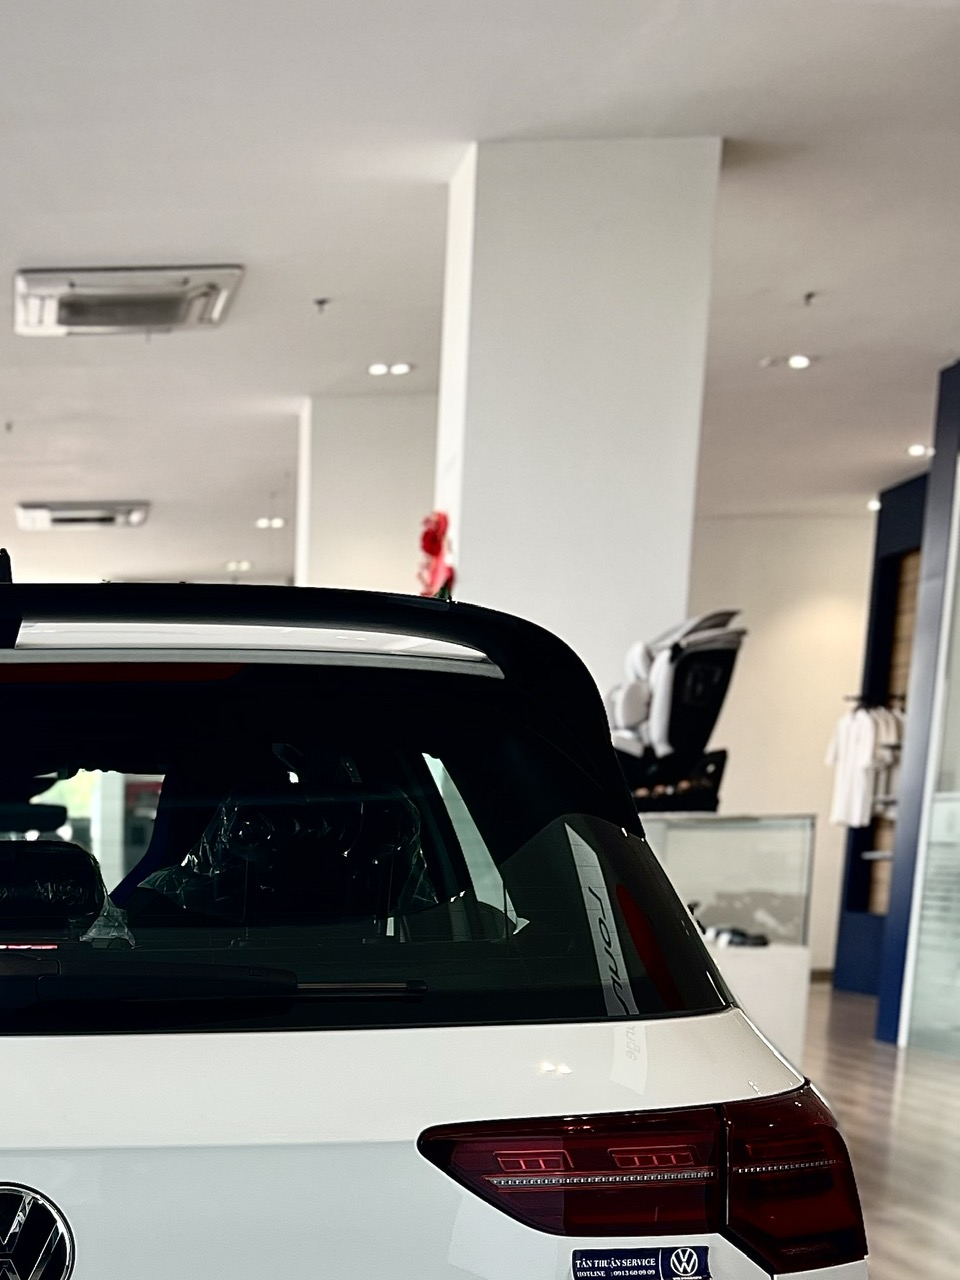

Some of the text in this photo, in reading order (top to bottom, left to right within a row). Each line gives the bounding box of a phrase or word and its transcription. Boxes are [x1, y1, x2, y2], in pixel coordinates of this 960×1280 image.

[575, 1257, 656, 1269] TÂN THUẬN SERVICE
